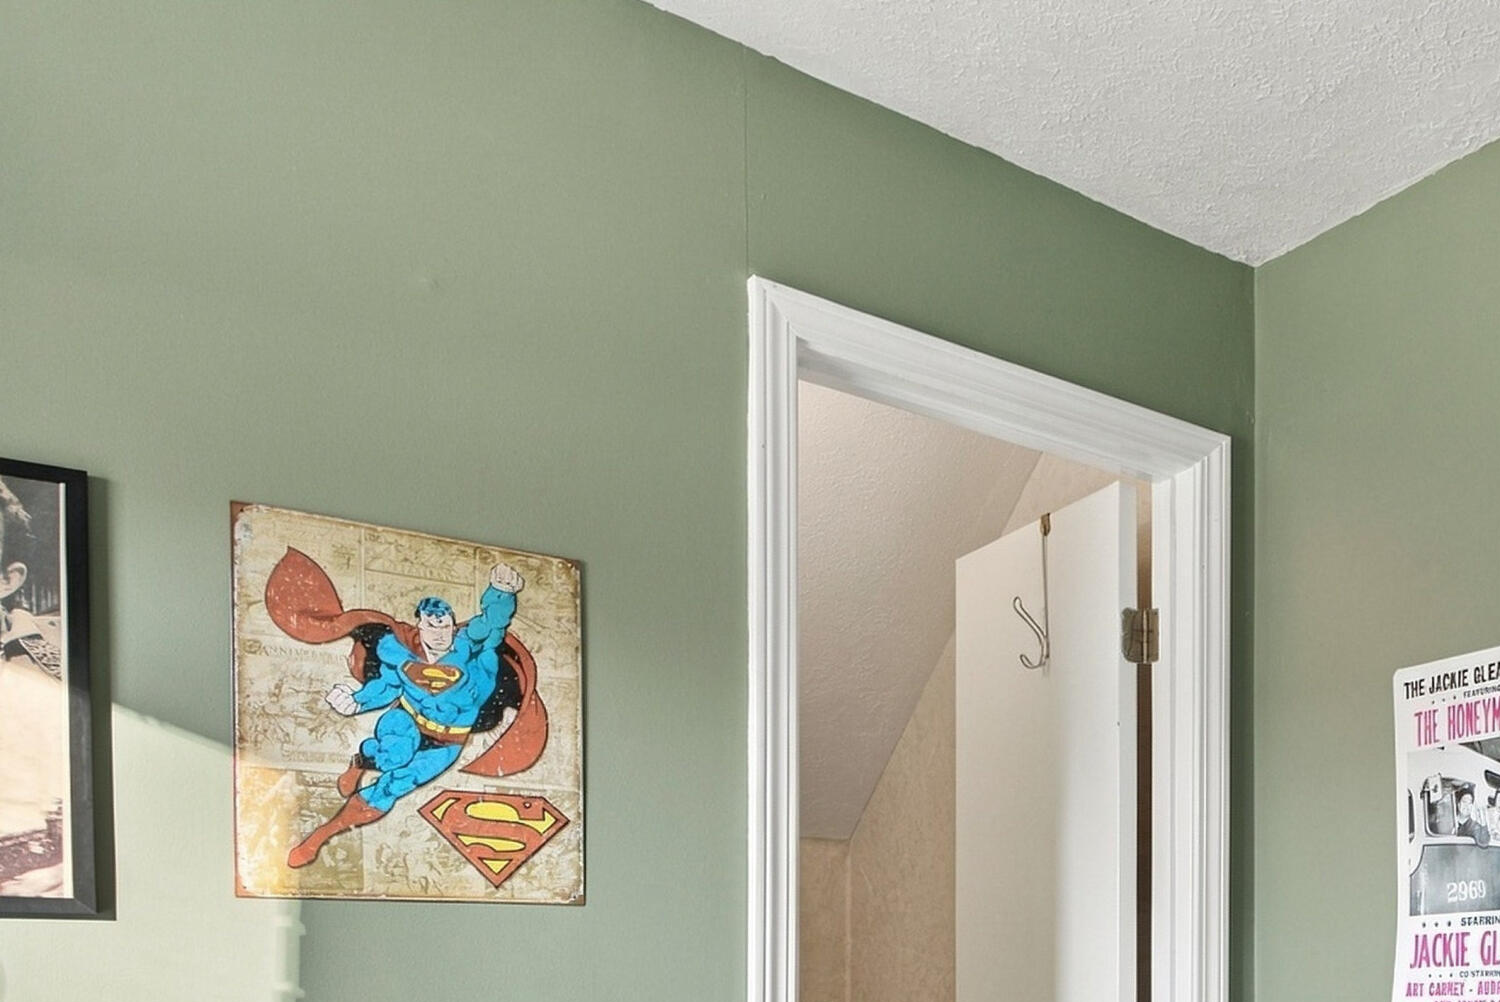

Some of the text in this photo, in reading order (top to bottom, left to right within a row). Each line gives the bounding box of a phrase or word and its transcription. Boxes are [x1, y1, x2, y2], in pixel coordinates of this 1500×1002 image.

[1404, 679, 1425, 699] THE
[1429, 669, 1469, 694] JACKIE
[1414, 709, 1440, 746] THE
[1447, 879, 1487, 902] 2969
[1409, 932, 1470, 969] JACKIE
[1405, 982, 1424, 997] ART
[1428, 982, 1465, 997] CARNEY
